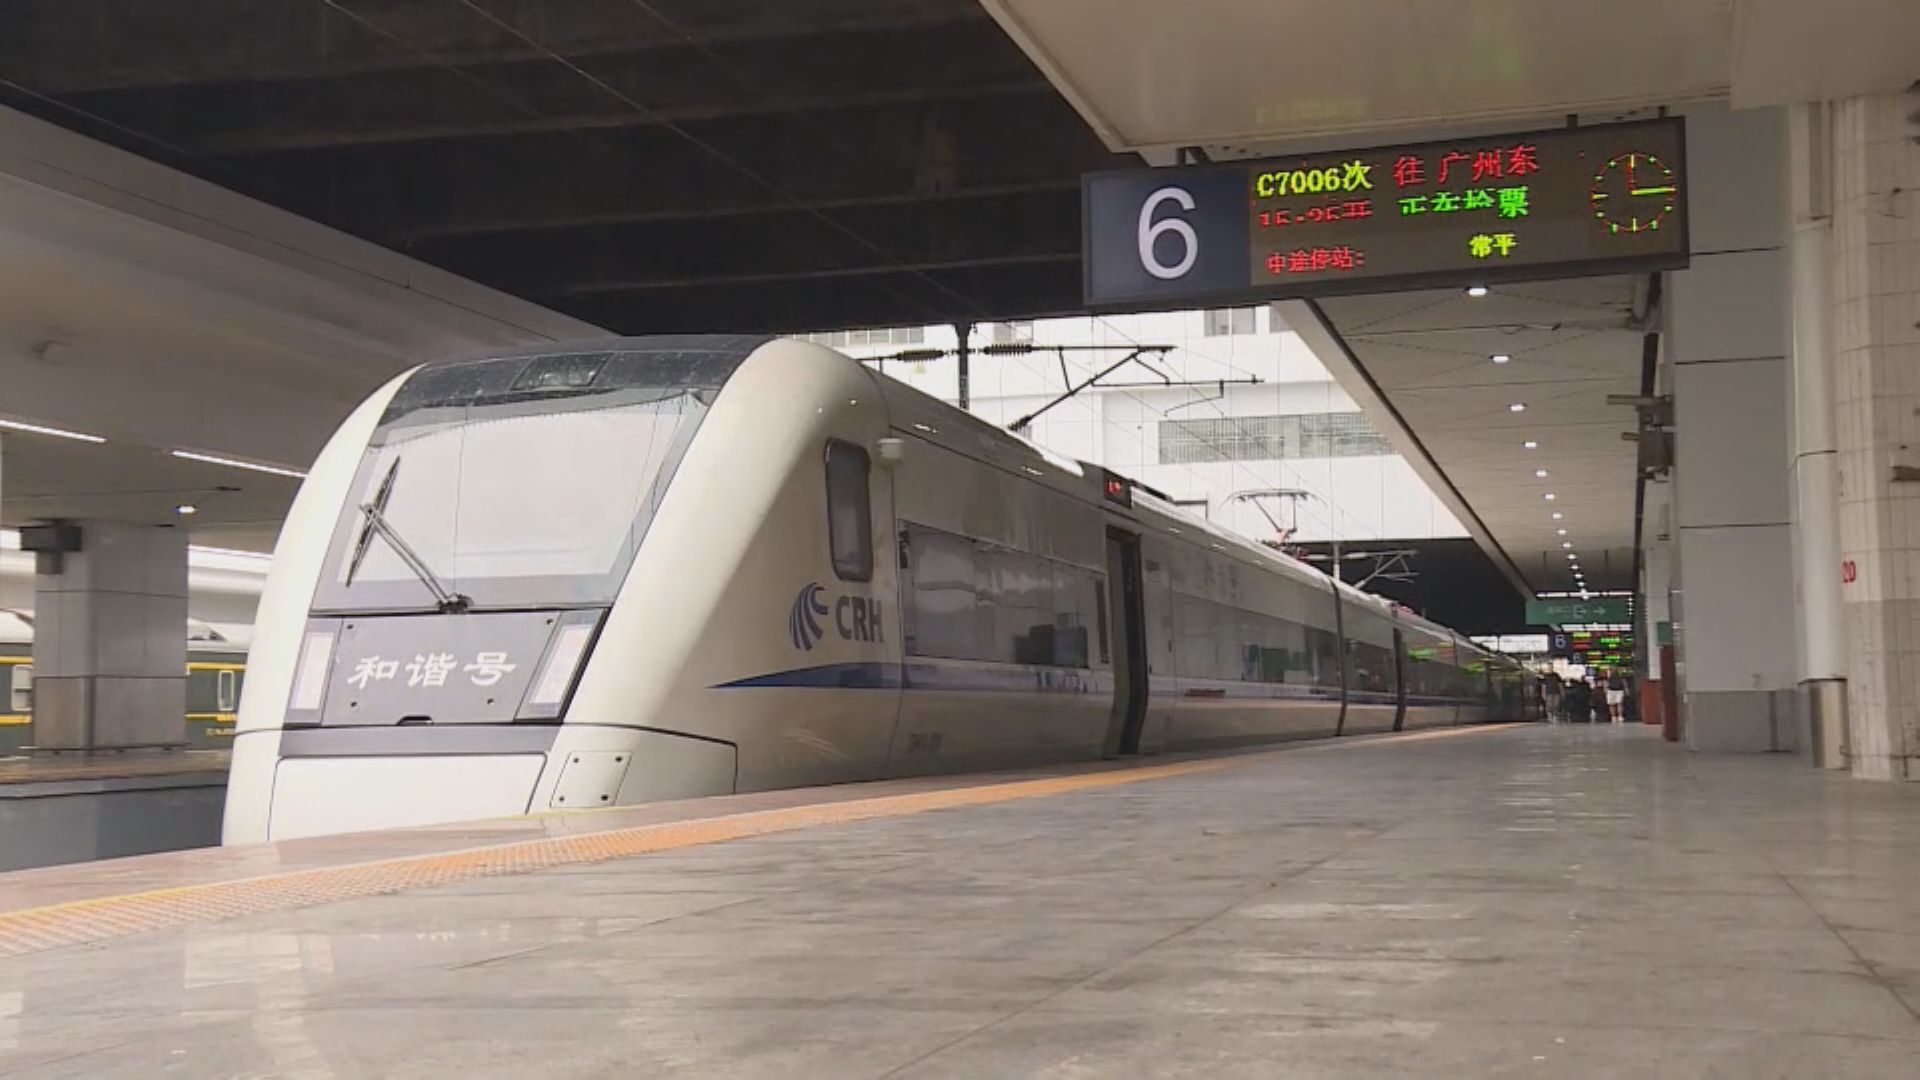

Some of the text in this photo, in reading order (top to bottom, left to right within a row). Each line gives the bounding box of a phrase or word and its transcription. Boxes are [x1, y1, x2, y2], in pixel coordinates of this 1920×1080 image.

[1257, 160, 1373, 197] C7006次
[1138, 187, 1198, 280] 6
[1469, 233, 1518, 258] 常平
[836, 596, 884, 643] CRH
[347, 651, 516, 690] 和谐号
